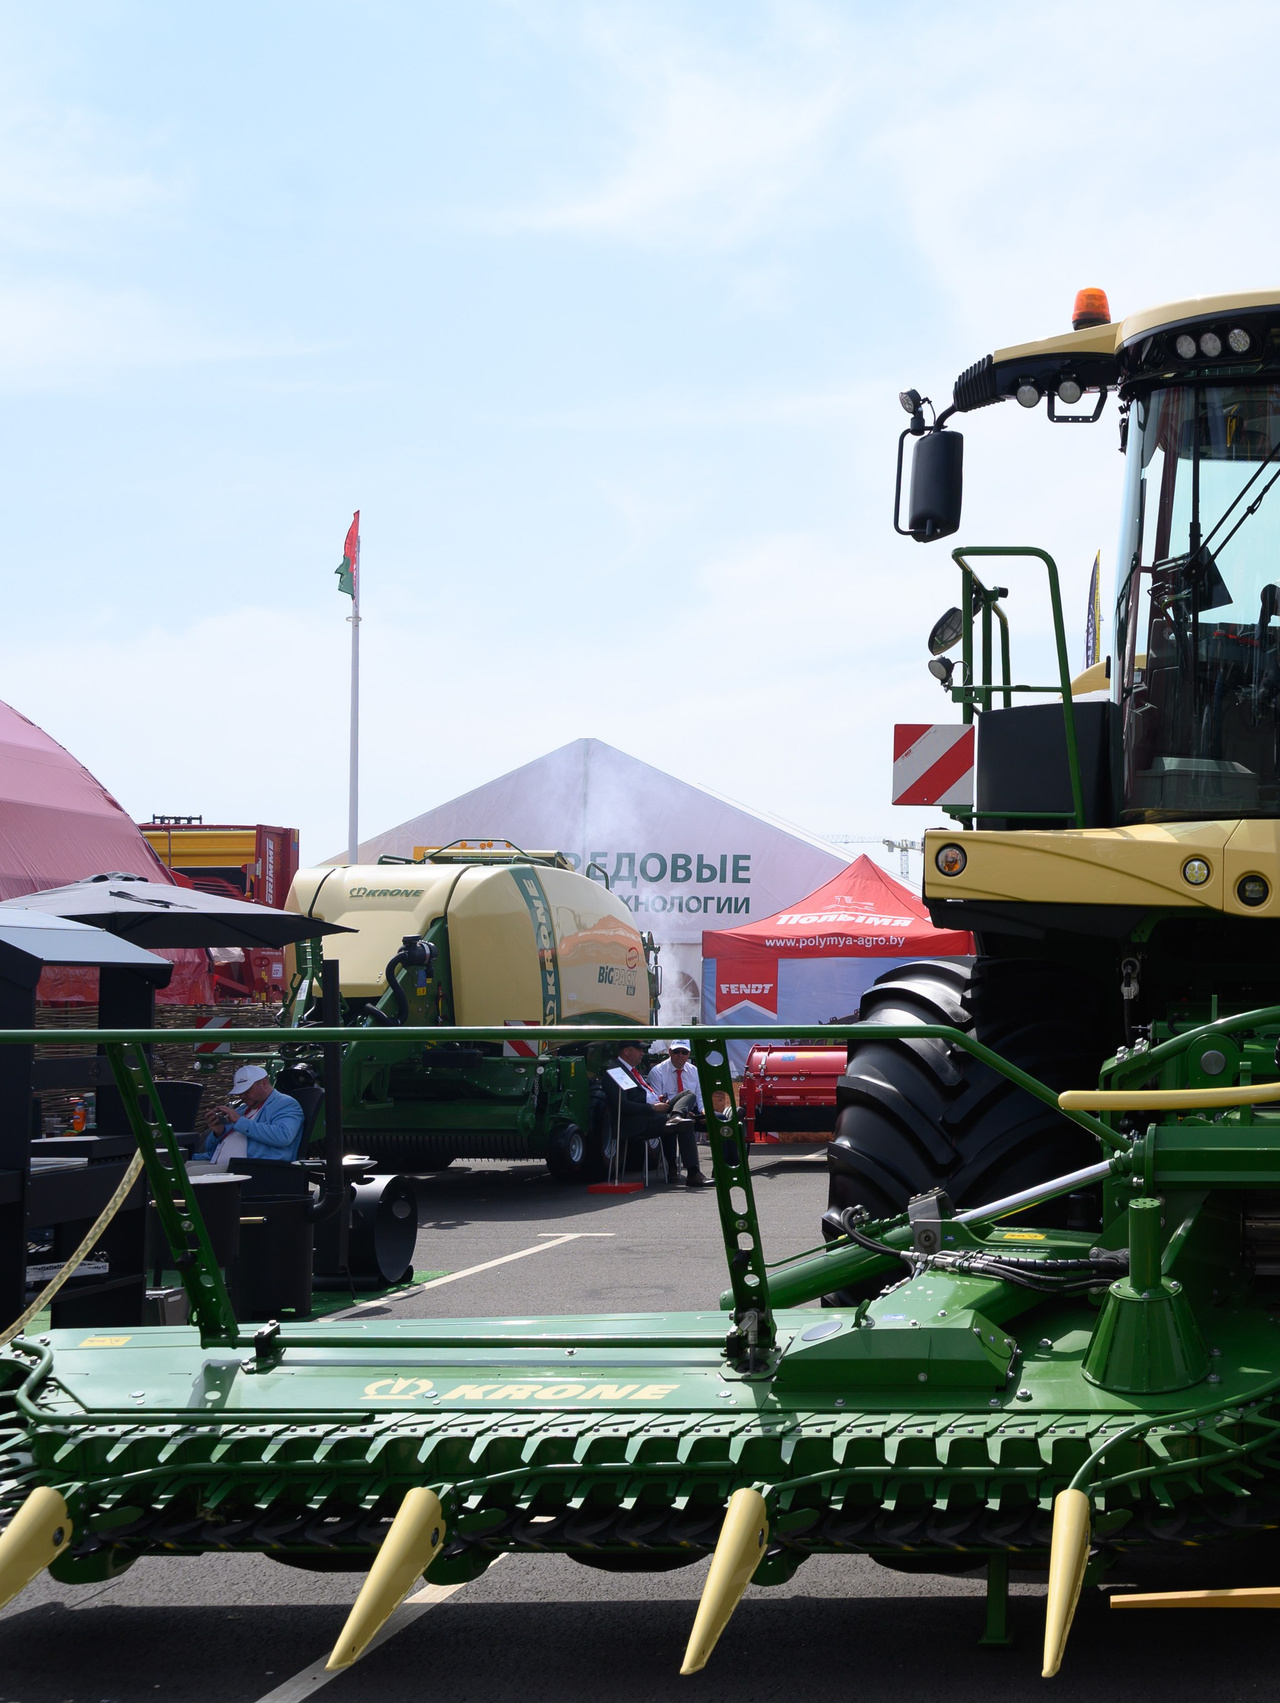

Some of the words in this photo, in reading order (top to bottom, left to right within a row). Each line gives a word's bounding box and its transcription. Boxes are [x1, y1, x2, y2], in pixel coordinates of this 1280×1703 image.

[365, 888, 426, 898] KRONE
[775, 911, 915, 927] Полымя
[522, 879, 556, 996] KRONE
[765, 935, 906, 948] www.polymya-agro.by
[719, 983, 774, 994] FENDT
[439, 1384, 681, 1400] KRONE
